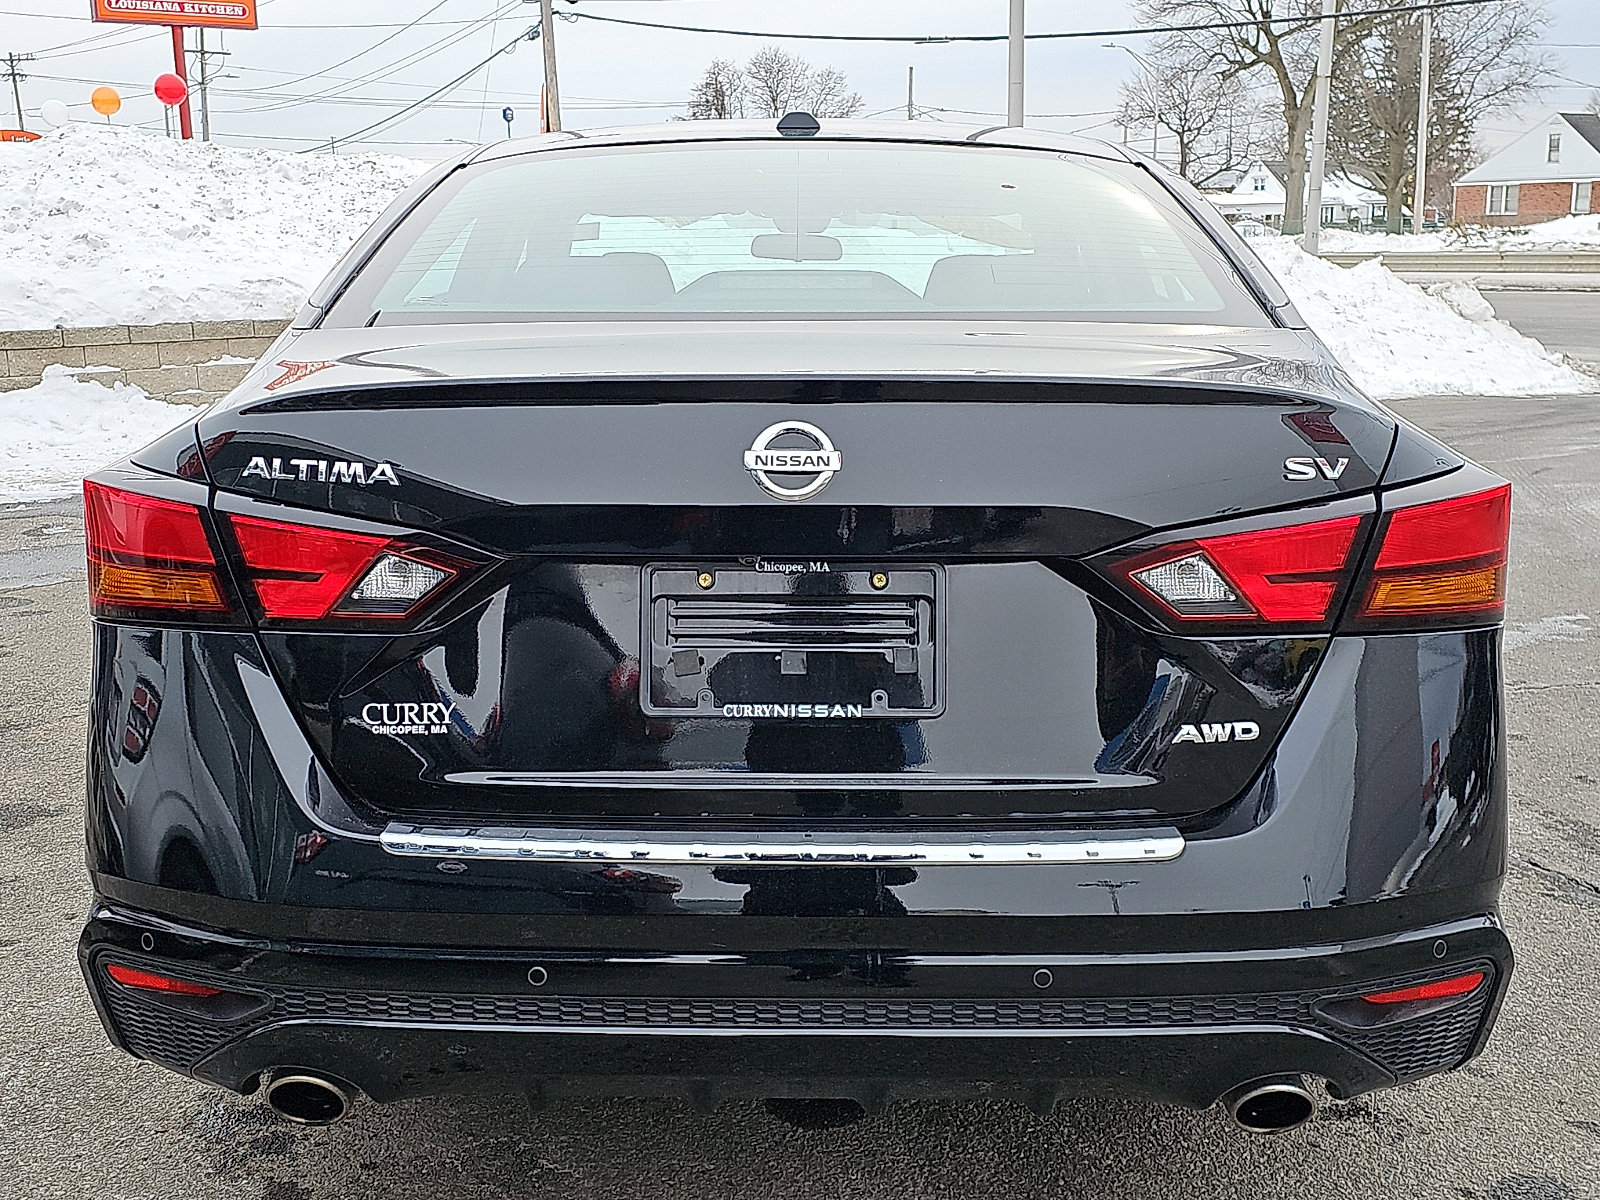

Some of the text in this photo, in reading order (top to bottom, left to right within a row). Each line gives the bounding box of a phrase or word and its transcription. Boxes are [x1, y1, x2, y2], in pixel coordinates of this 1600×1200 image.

[110, 0, 244, 15] LOUISIANA KITCHEN
[754, 455, 830, 467] NISSAN
[1283, 457, 1350, 481] SV
[242, 456, 399, 486] ALTIMA
[755, 561, 830, 574] Chicopee, MA
[362, 702, 457, 725] CURRY
[371, 725, 448, 735] CHICOPEE, MA
[1171, 721, 1260, 744] AWD
